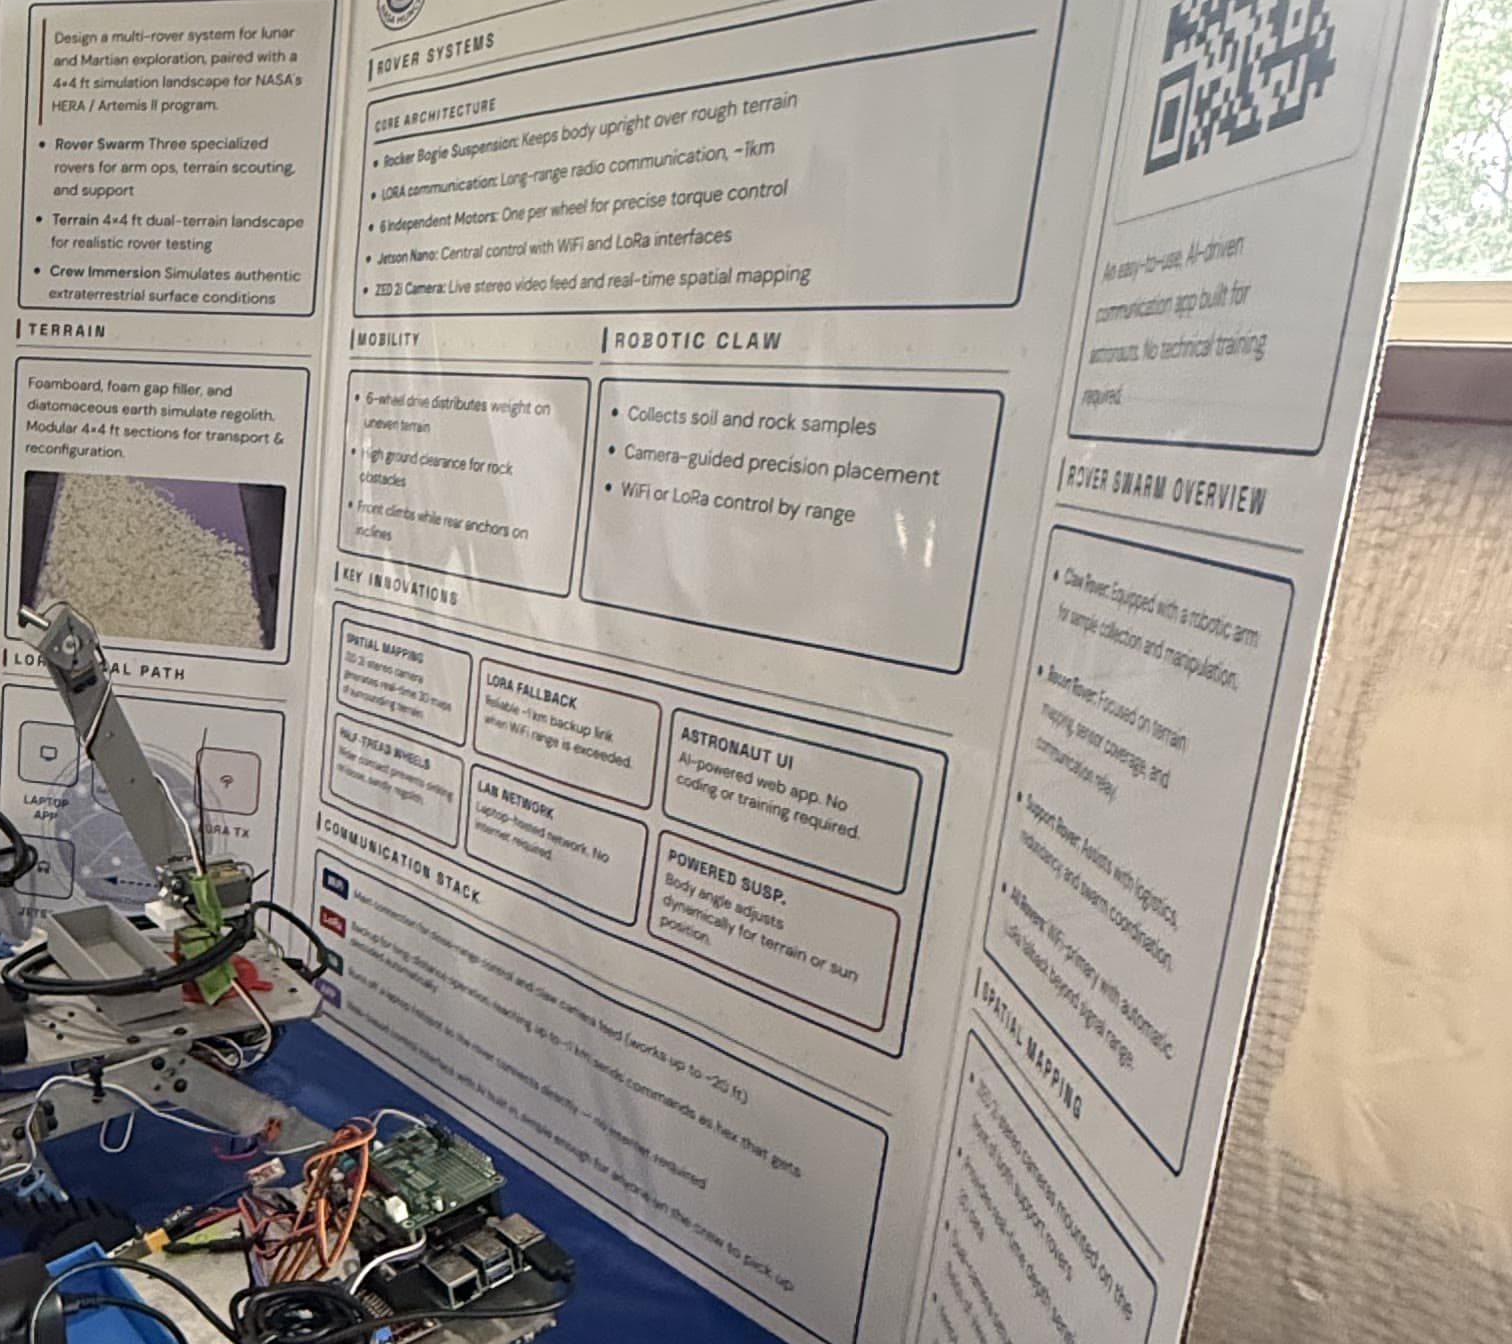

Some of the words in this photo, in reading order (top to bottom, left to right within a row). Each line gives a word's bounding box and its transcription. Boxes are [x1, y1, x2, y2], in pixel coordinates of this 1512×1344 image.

[54, 31, 98, 47] Design
[100, 33, 109, 44] a
[111, 30, 184, 43] multi-rover
[187, 30, 235, 44] system
[239, 26, 258, 40] for
[261, 26, 296, 40] lunar
[53, 54, 78, 67] and
[81, 54, 129, 66] Martian
[210, 51, 254, 67] paired
[257, 49, 286, 63] with
[289, 52, 298, 63] a
[377, 51, 420, 75] ROVER
[426, 32, 494, 63] SYSTEMS
[80, 76, 90, 89] ft
[93, 76, 159, 89] simulation
[162, 75, 230, 91] landscape
[233, 74, 252, 87] for
[52, 100, 85, 112] HERA
[97, 99, 148, 112] Artemis
[374, 115, 400, 133] CORE
[403, 97, 496, 126] ARCHITECTURE
[417, 146, 449, 165] Bogie
[521, 130, 559, 148] Keeps
[561, 123, 597, 142] body
[599, 114, 651, 139] upright
[654, 110, 688, 128] over
[691, 100, 737, 124] rough
[743, 91, 798, 115] terrain
[55, 137, 94, 151] Rover
[97, 137, 145, 151] Swarm
[149, 136, 187, 151] Three
[190, 136, 269, 154] specialized
[54, 163, 95, 174] rovers
[99, 160, 117, 174] for
[120, 163, 147, 174] arm
[183, 160, 228, 174] terrain
[53, 183, 78, 196] and
[81, 186, 134, 200] support
[52, 213, 99, 226] Terrain
[131, 214, 142, 226] ft
[146, 214, 228, 228] dual-terrain
[231, 214, 305, 232] landscape
[51, 235, 69, 248] for
[72, 236, 123, 249] realistic
[127, 239, 162, 250] rover
[166, 238, 213, 255] testing
[49, 264, 85, 277] Crew
[88, 265, 161, 279] Immersion
[164, 266, 231, 281] Simulates
[234, 268, 302, 282] authentic
[48, 288, 145, 302] extraterrestrial
[148, 289, 199, 303] surface
[202, 291, 276, 305] conditions
[28, 323, 105, 338] TERRAIN
[357, 332, 420, 347] MOBILITY
[615, 331, 705, 349] ROBOTIC
[716, 331, 782, 350] CLAW
[28, 376, 103, 393] Foamboard,
[107, 379, 140, 393] foam
[143, 384, 169, 398] gap
[206, 385, 233, 398] and
[27, 398, 118, 414] diatomaceous
[121, 403, 157, 416] earth
[160, 405, 218, 419] simulate
[26, 420, 78, 434] Modular
[110, 424, 120, 437] ft
[124, 426, 179, 440] sections
[183, 427, 202, 440] for
[206, 430, 269, 445] transport
[273, 431, 284, 445] &
[627, 405, 687, 425] Collects
[690, 409, 719, 426] soil
[722, 410, 755, 428] and
[757, 413, 796, 431] rock
[801, 416, 877, 439] samples
[624, 443, 745, 470] Camera-guided
[747, 454, 829, 476] precision
[832, 460, 940, 487] placement
[1067, 464, 1108, 489] ROVER
[1112, 470, 1167, 499] SWARM
[1172, 477, 1267, 515] OVERVIEW
[621, 481, 651, 500] WiFi
[653, 488, 670, 502] or
[672, 487, 710, 507] LoRa
[713, 495, 775, 514] control
[777, 497, 801, 521] by
[805, 505, 856, 527] range
[343, 567, 363, 583] KEY
[368, 573, 458, 606] INNOVATIONS
[140, 665, 185, 679] PATH
[487, 673, 514, 692] LORA
[516, 682, 578, 710] FALLBACK
[681, 727, 772, 764] ASTRONAUT
[776, 752, 794, 771] UI
[477, 780, 499, 798] LAN
[501, 788, 554, 821] NETWORK
[324, 818, 430, 879] COMMUNICATION
[436, 871, 480, 904] STACK
[668, 849, 737, 886] POWERED
[741, 876, 787, 906] SUSP.
[982, 981, 1022, 1046] SPATIAL
[1027, 1035, 1082, 1119] MAPPING
